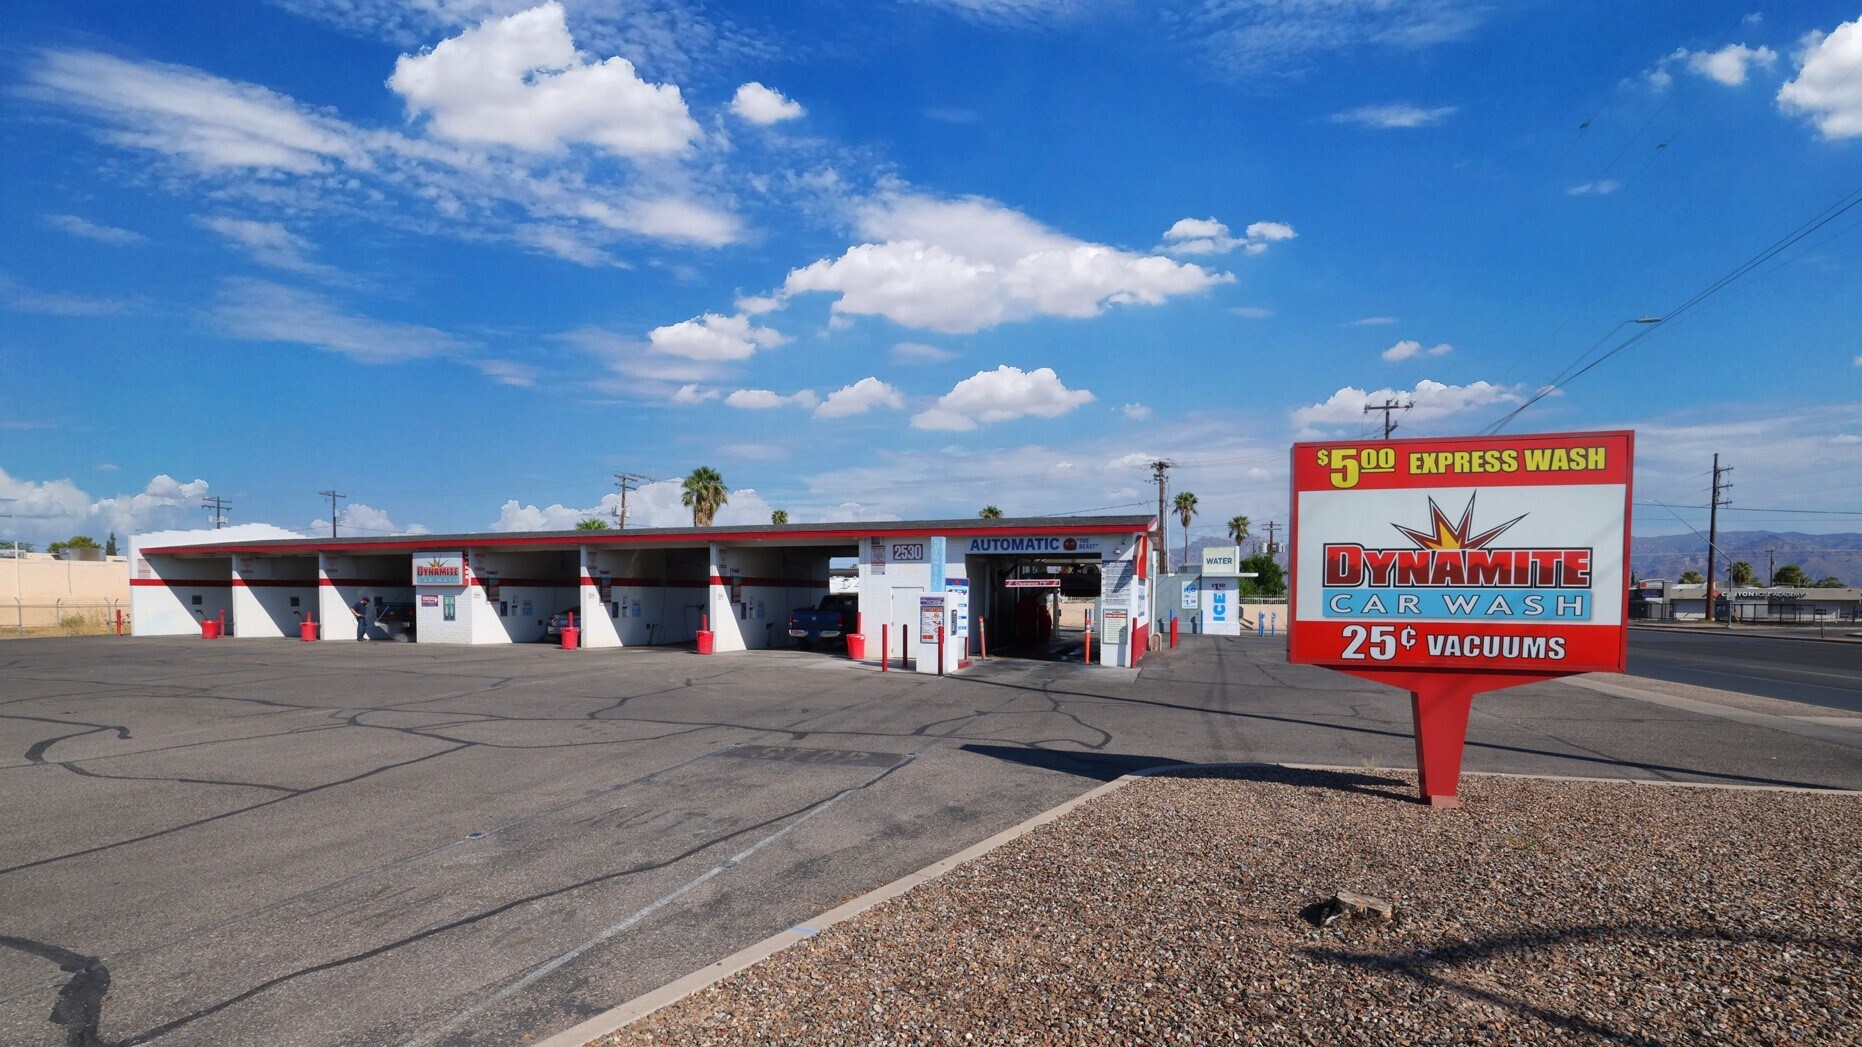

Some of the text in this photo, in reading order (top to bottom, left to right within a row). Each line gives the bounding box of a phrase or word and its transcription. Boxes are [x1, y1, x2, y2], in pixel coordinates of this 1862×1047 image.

[1408, 449, 1518, 475] EXPRESS
[1524, 446, 1606, 471] WASH
[894, 545, 922, 560] 2530
[970, 538, 1060, 552] AUTOMATIC
[417, 566, 459, 576] DYNAMITE
[1322, 542, 1594, 588] DYNAMITE
[1213, 592, 1226, 621] ICE
[1329, 593, 1584, 616] CAR WASH
[1340, 624, 1567, 661] 25¢ VACUUMS
